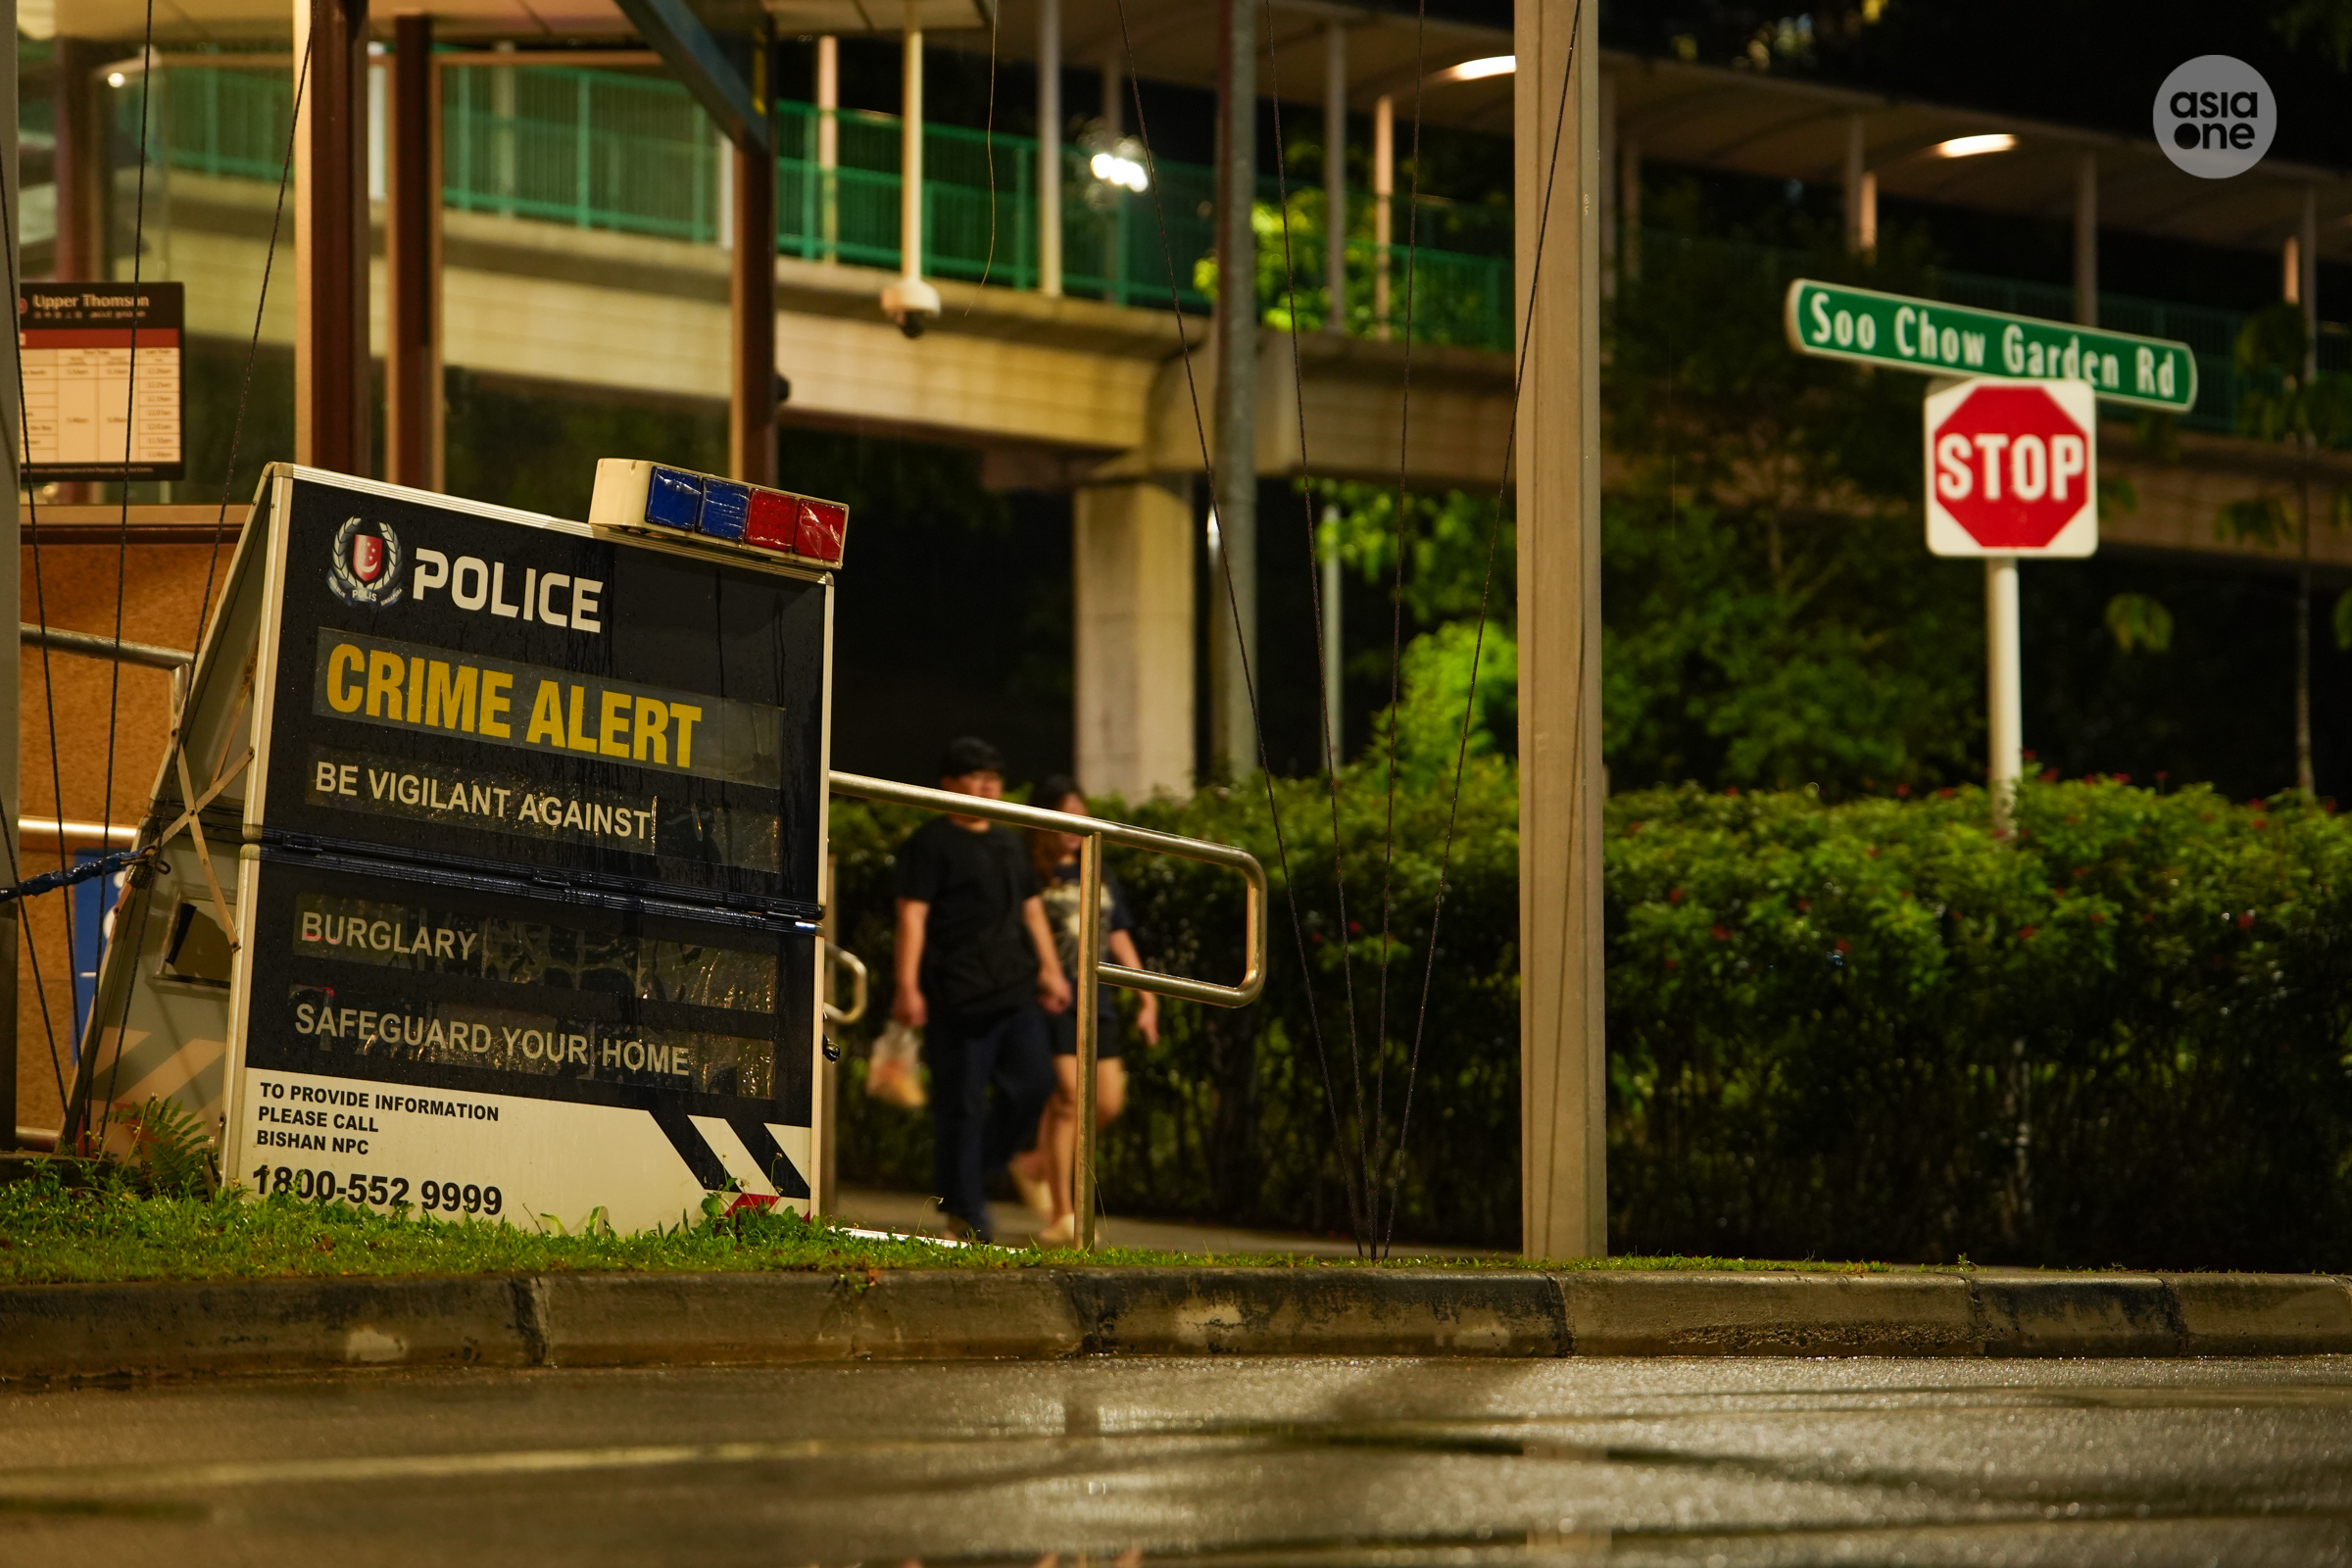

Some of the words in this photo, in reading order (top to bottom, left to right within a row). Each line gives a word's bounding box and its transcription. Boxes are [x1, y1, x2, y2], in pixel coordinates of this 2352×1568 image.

[32, 294, 78, 311] Upper
[81, 294, 150, 307] Thomson
[1810, 291, 1877, 350] Soo
[1894, 306, 1985, 368] Chow
[2001, 323, 2120, 389] Garden
[2135, 345, 2176, 398] Rd
[1936, 433, 2085, 501] STOP
[413, 547, 605, 634] POLICE
[326, 643, 514, 740] CRIME
[526, 679, 703, 769] ALERT
[315, 760, 360, 798] BE
[368, 768, 512, 819] VIGILANT
[517, 792, 653, 841] AGAINST
[300, 910, 478, 961] BURGLARY
[295, 1003, 492, 1054] SAFEGUARD
[501, 1026, 588, 1065] YOUR
[601, 1041, 690, 1076] HOME
[258, 1105, 328, 1128] PLEASE
[333, 1113, 379, 1133] CALL
[260, 1082, 284, 1099] TO
[290, 1085, 369, 1108] PROVIDE
[374, 1094, 499, 1122] INFORMATION
[256, 1129, 326, 1152] BISHAN
[331, 1137, 369, 1155] NPC
[253, 1164, 410, 1206] 1800-552
[419, 1180, 503, 1215] 9999
